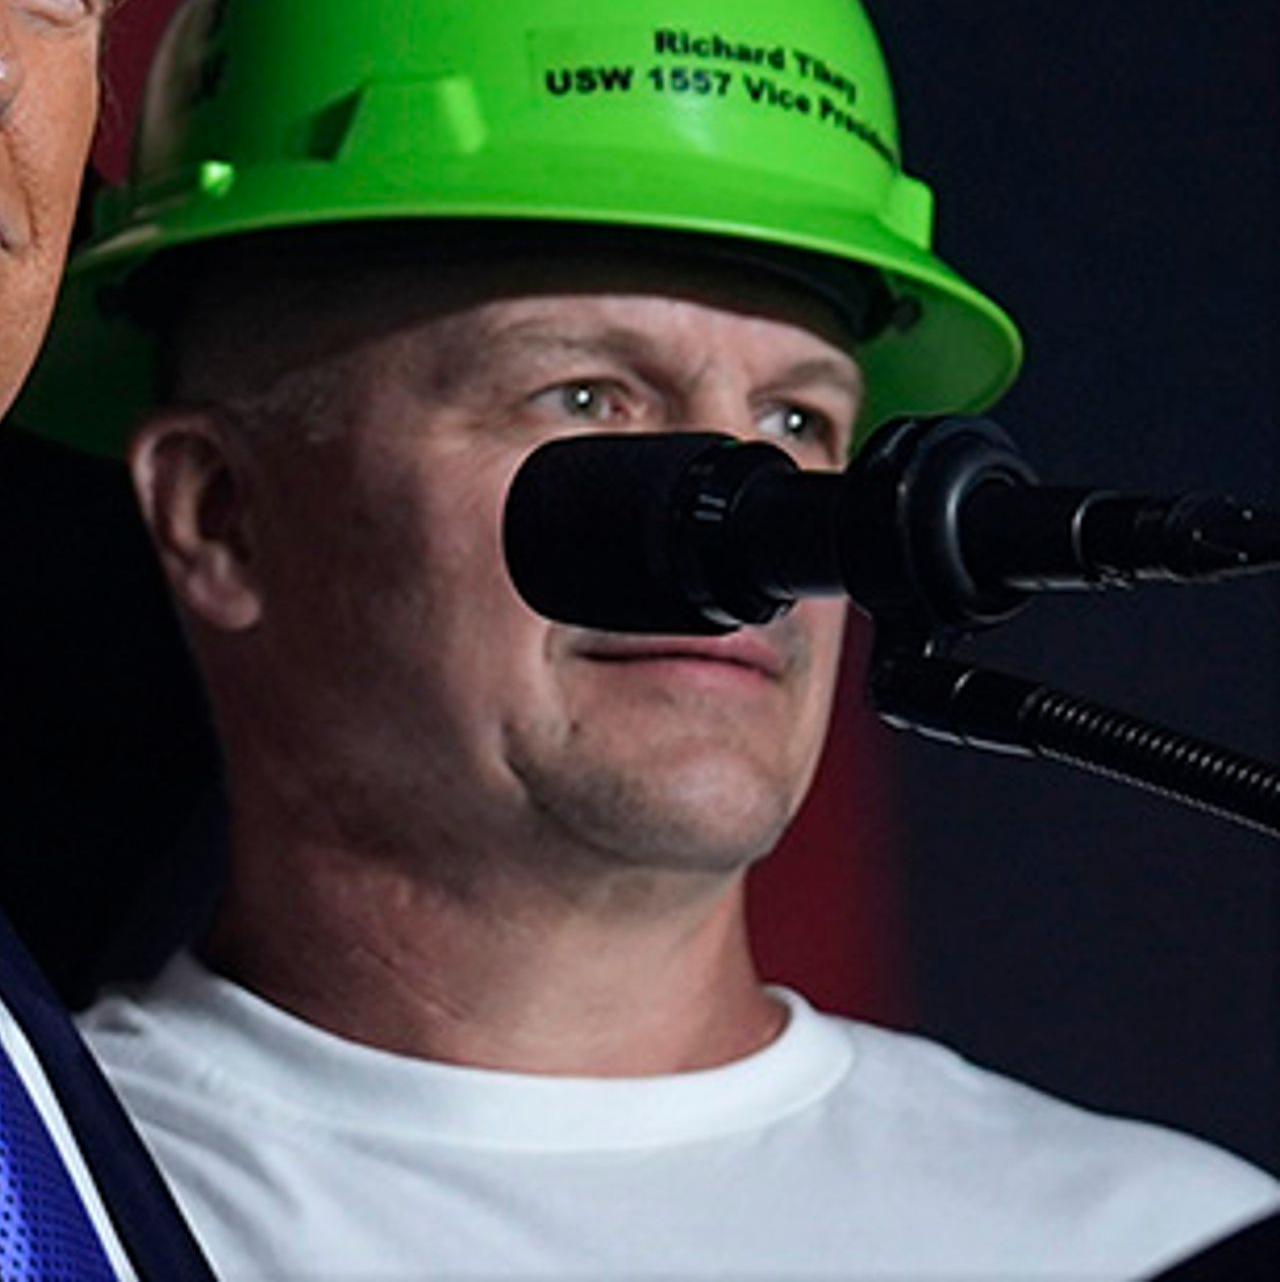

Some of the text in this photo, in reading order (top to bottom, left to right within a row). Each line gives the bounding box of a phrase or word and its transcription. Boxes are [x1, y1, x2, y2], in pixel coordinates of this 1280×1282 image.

[654, 29, 786, 70] Richard
[545, 66, 634, 96] USW
[648, 66, 732, 96] 1557
[742, 72, 811, 115] Vice
